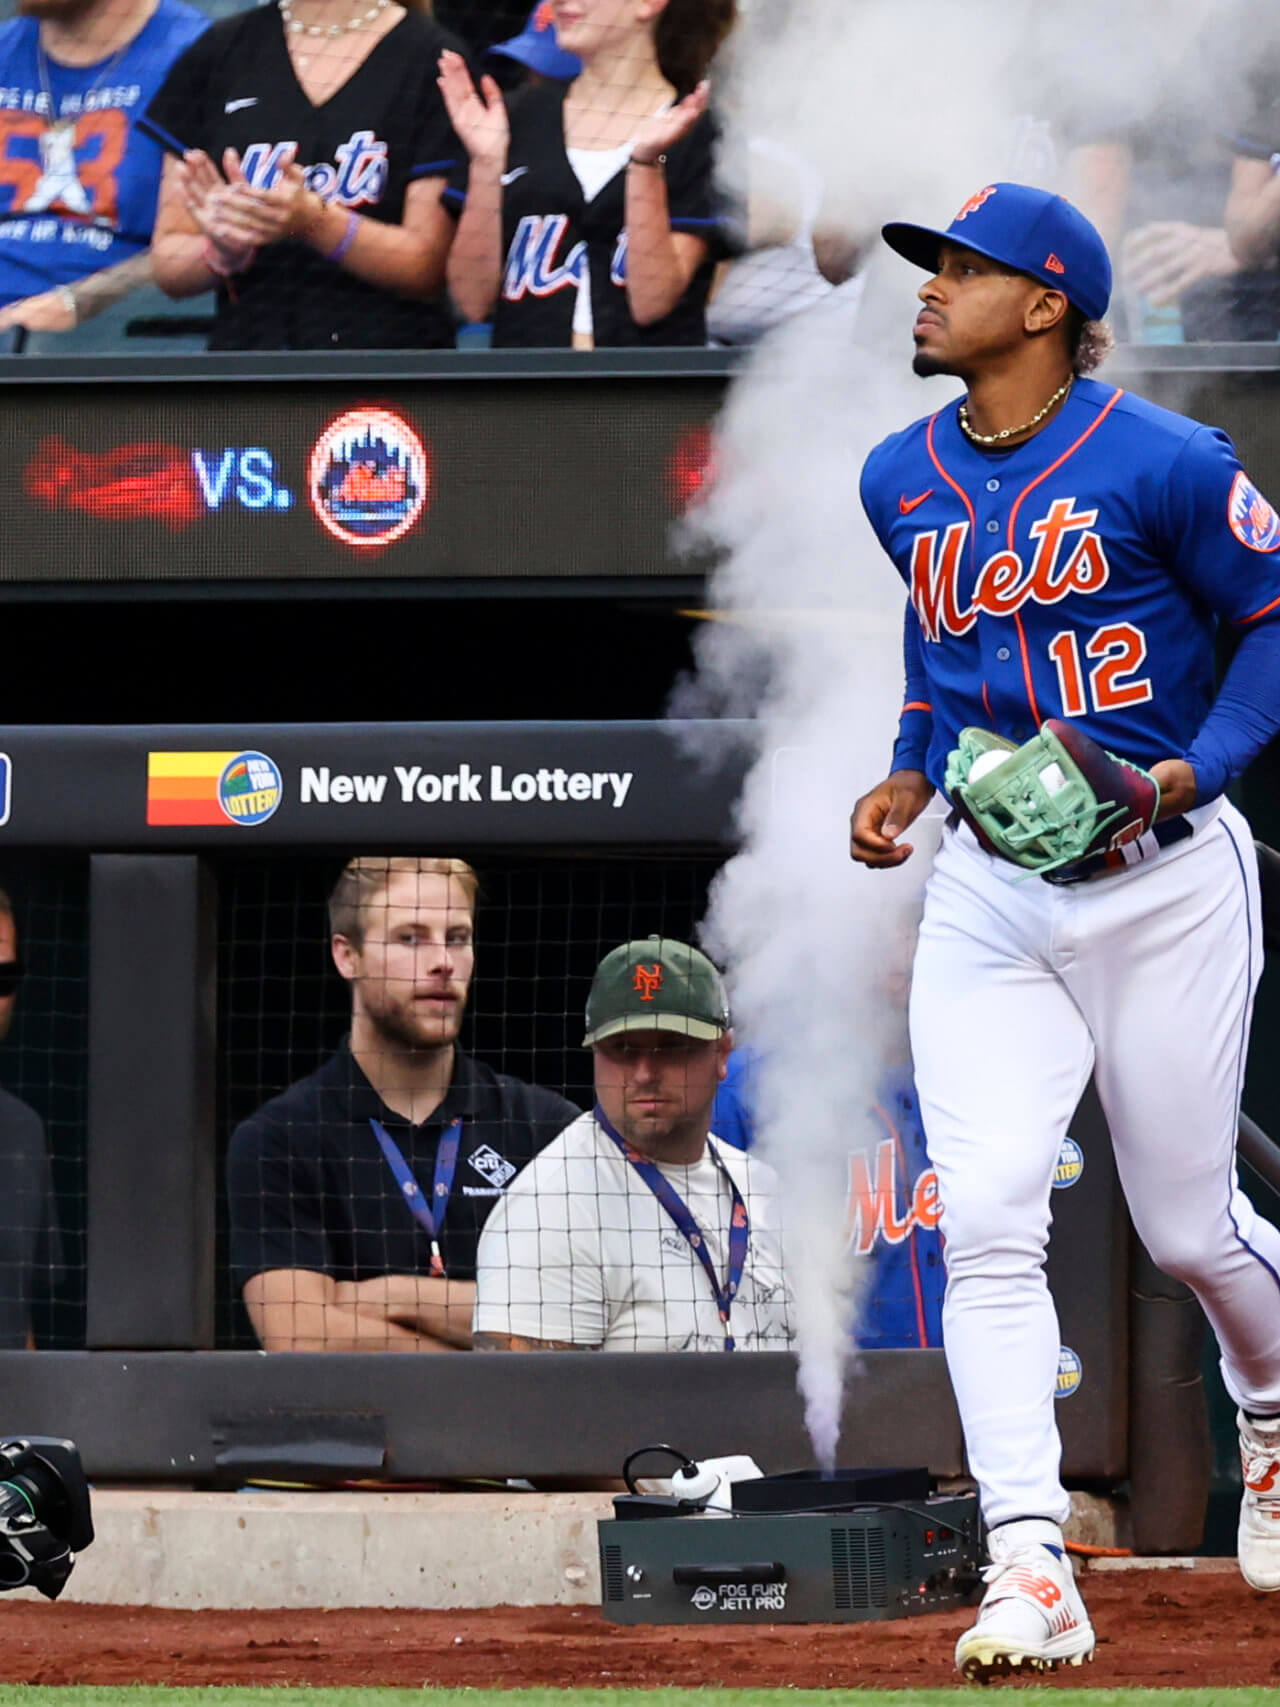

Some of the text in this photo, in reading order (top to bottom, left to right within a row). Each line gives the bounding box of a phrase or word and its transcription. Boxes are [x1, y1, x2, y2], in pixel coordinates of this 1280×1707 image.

[191, 447, 293, 512] VS.
[910, 497, 1110, 643] Mets
[1048, 621, 1153, 717] 12
[300, 764, 634, 808] New York Lottery
[633, 964, 663, 1001] NY
[719, 1583, 788, 1597] FOG FURY
[719, 1597, 786, 1610] JETT PRO
